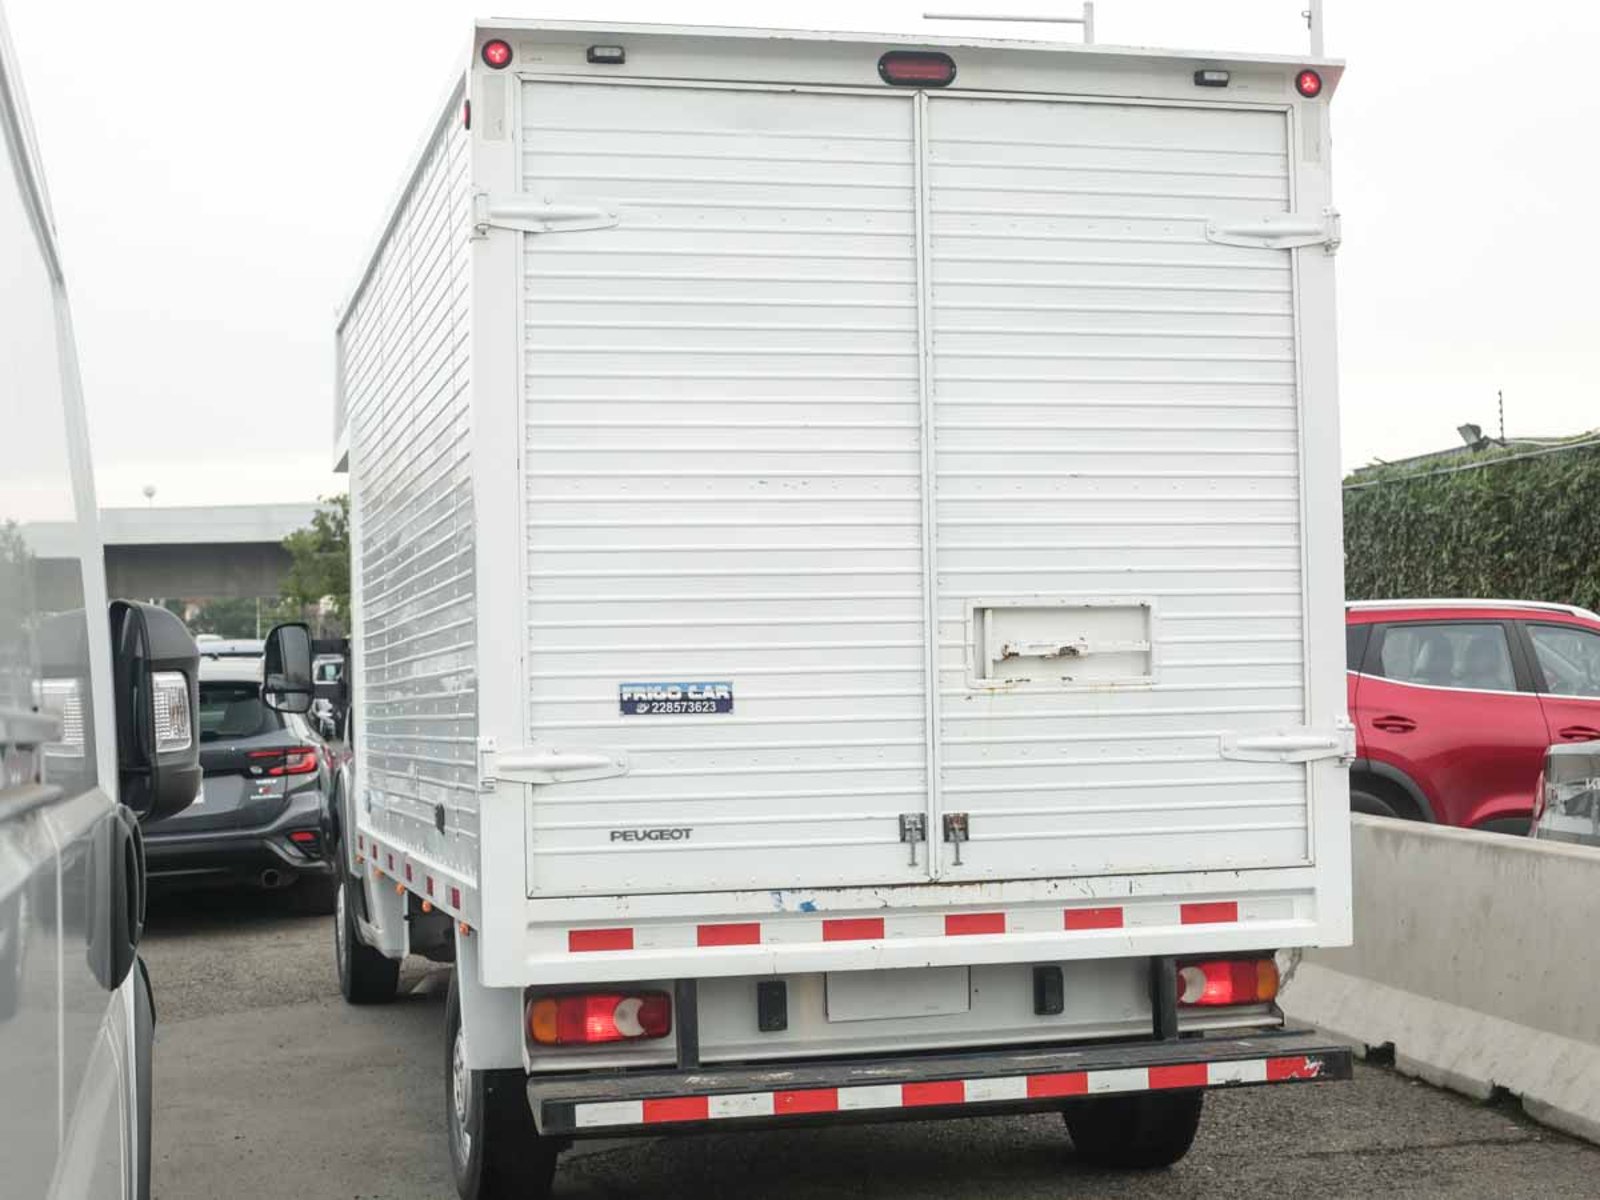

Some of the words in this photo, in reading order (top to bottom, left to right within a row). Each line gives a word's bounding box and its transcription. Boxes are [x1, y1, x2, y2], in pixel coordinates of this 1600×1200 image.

[687, 684, 730, 700] CAR
[651, 701, 717, 714] 228573623
[610, 828, 694, 842] PEUGEOT
